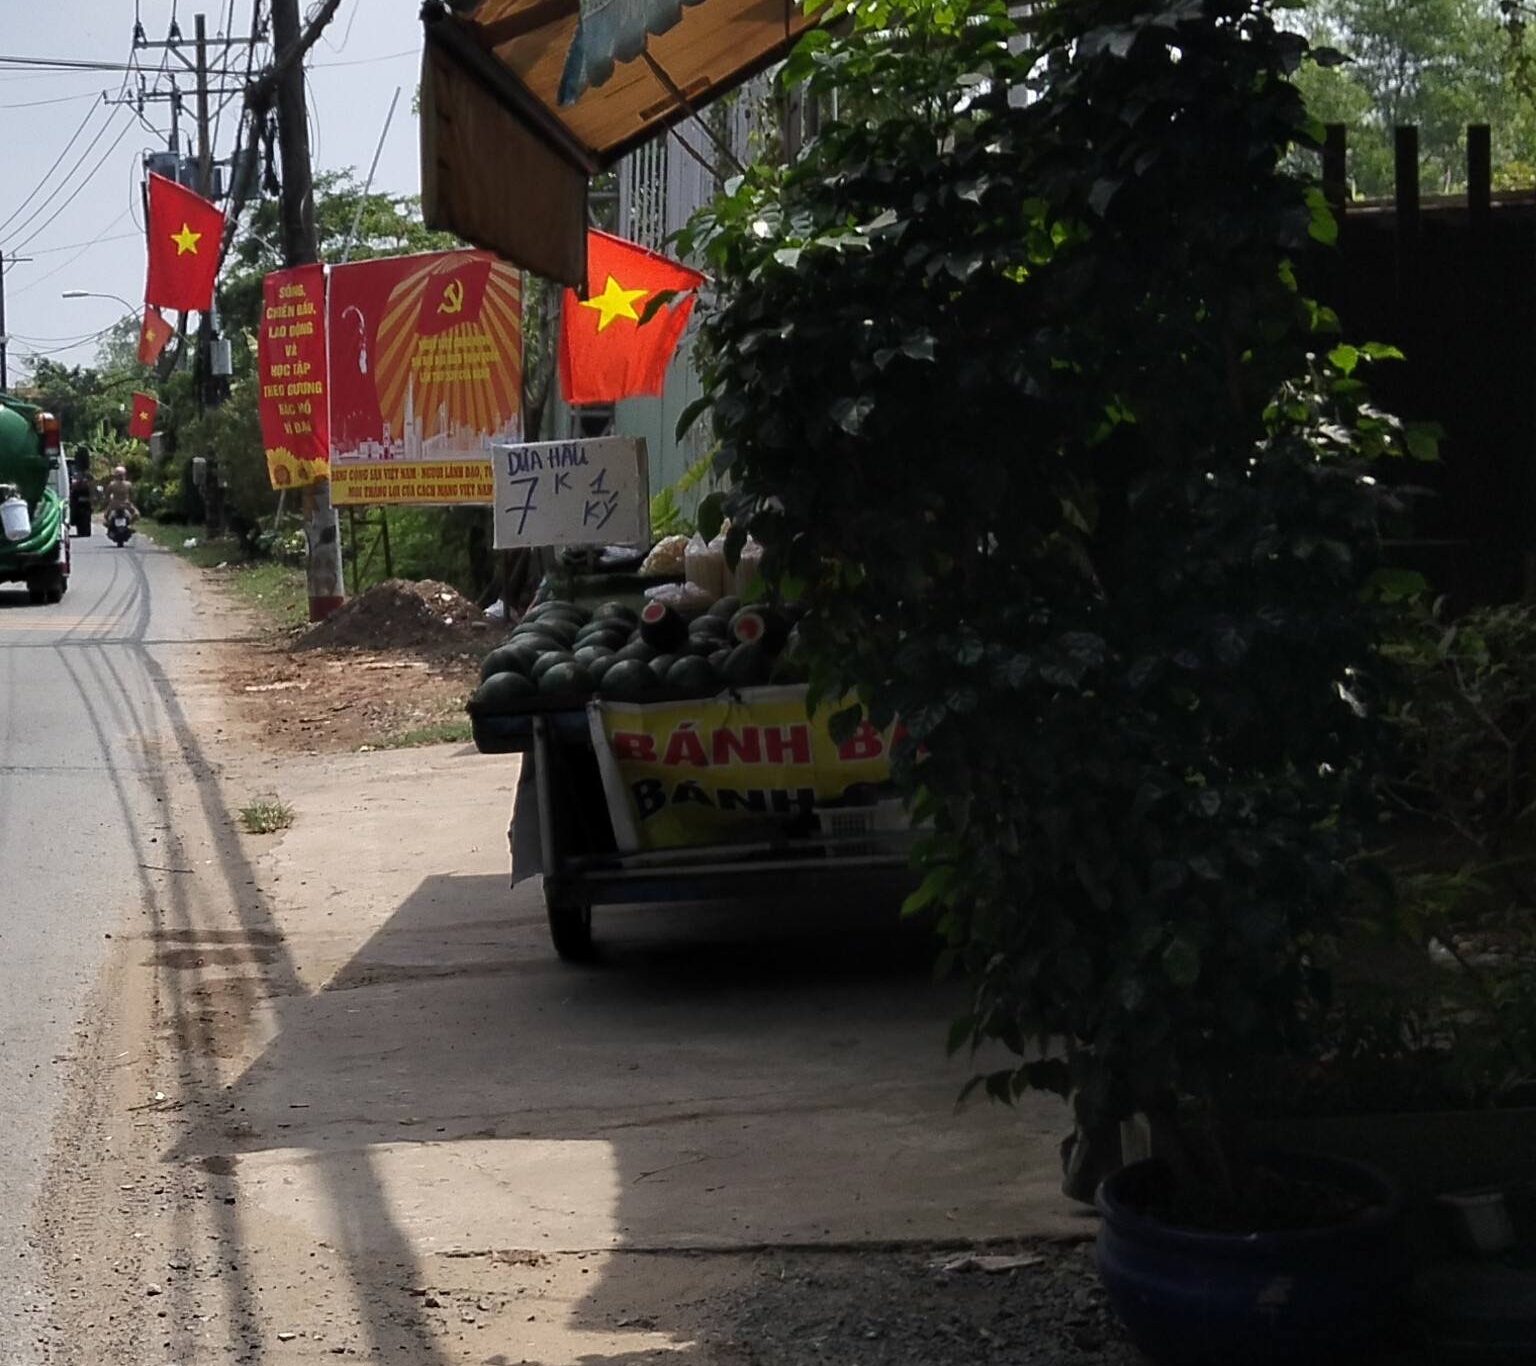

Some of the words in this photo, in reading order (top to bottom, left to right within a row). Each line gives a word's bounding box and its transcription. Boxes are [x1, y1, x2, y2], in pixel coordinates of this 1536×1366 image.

[268, 325, 287, 339] LAO
[264, 384, 285, 398] THEO
[270, 363, 291, 379] HỌC
[505, 476, 539, 535] 7
[554, 471, 572, 495] K
[589, 467, 610, 495] 1
[583, 490, 619, 530] KÝ
[612, 718, 812, 767] BÁNH
[631, 778, 816, 821] BÁNH
